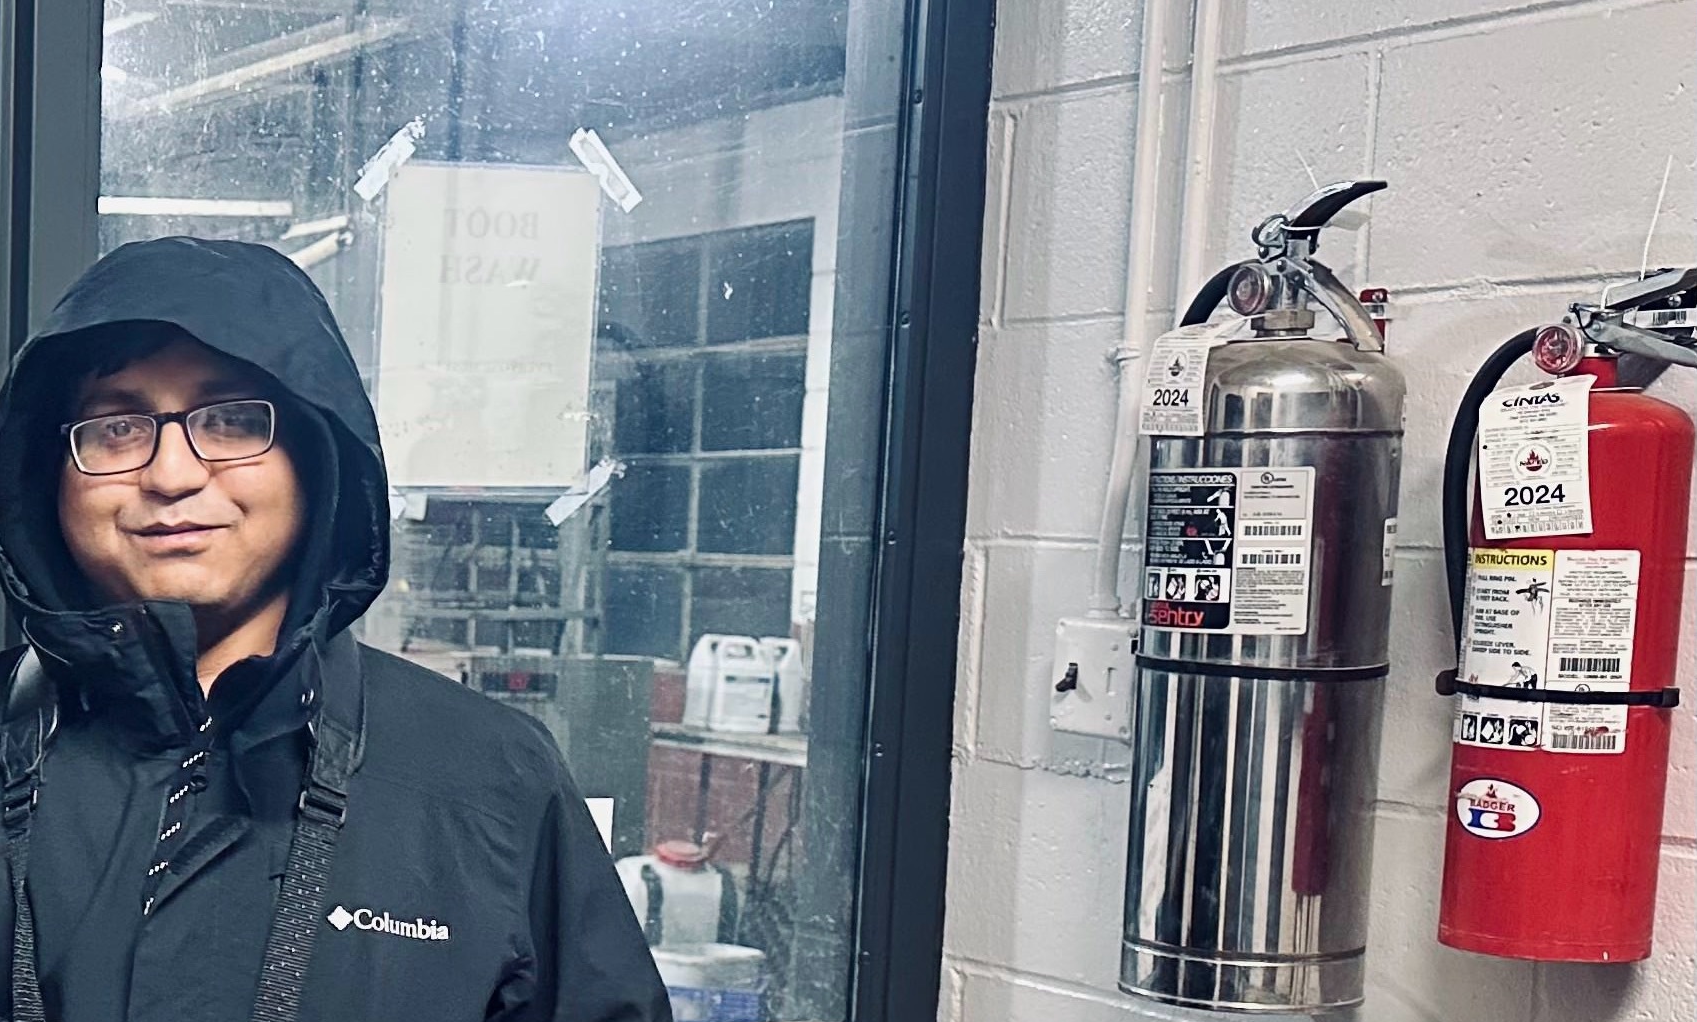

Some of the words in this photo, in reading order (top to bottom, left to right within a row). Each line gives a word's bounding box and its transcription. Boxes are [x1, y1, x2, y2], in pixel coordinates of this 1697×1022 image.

[1152, 388, 1190, 408] 2024
[1501, 392, 1561, 408] CINTAS
[1504, 483, 1566, 507] 2024
[1474, 553, 1548, 566] INSTRUCTIONS
[1469, 799, 1516, 812] BADGER
[352, 908, 449, 941] Columbia
